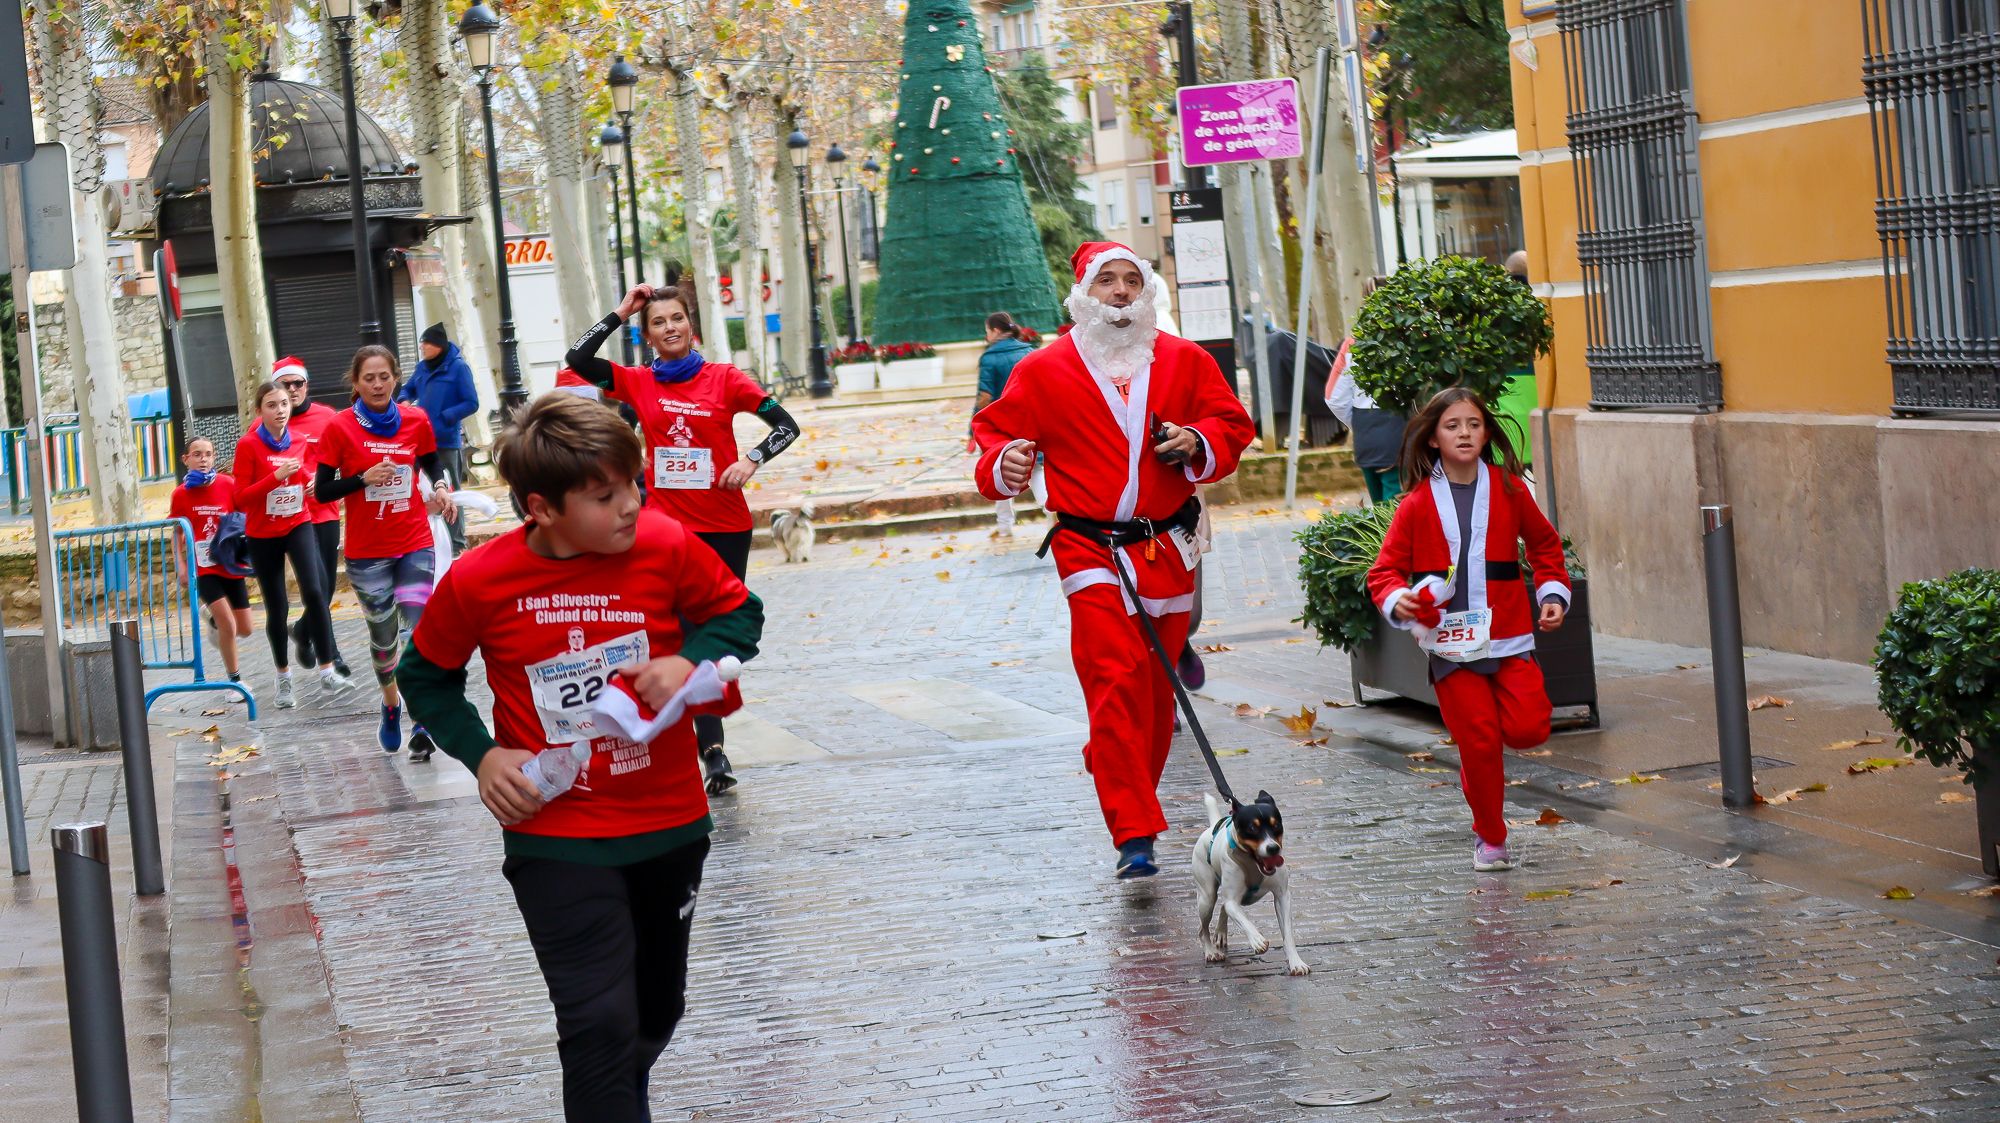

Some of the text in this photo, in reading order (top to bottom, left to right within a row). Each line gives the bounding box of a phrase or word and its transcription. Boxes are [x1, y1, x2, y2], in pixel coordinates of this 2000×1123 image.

[1200, 106, 1275, 122] Zona libre
[1194, 121, 1283, 138] de violencia
[1203, 138, 1277, 152] de género
[665, 460, 697, 472] 234
[517, 598, 524, 612] I
[525, 596, 550, 610] San
[552, 593, 609, 608] Silvestre
[536, 608, 645, 624] Ciudad de Lucena
[1436, 627, 1475, 643] 251
[541, 666, 556, 676] San
[555, 660, 586, 673] Silvestre
[543, 671, 568, 683] Ciudad
[577, 664, 603, 676] Lucena
[612, 743, 649, 762] HURTADO
[609, 754, 651, 776] MARJALIZO
